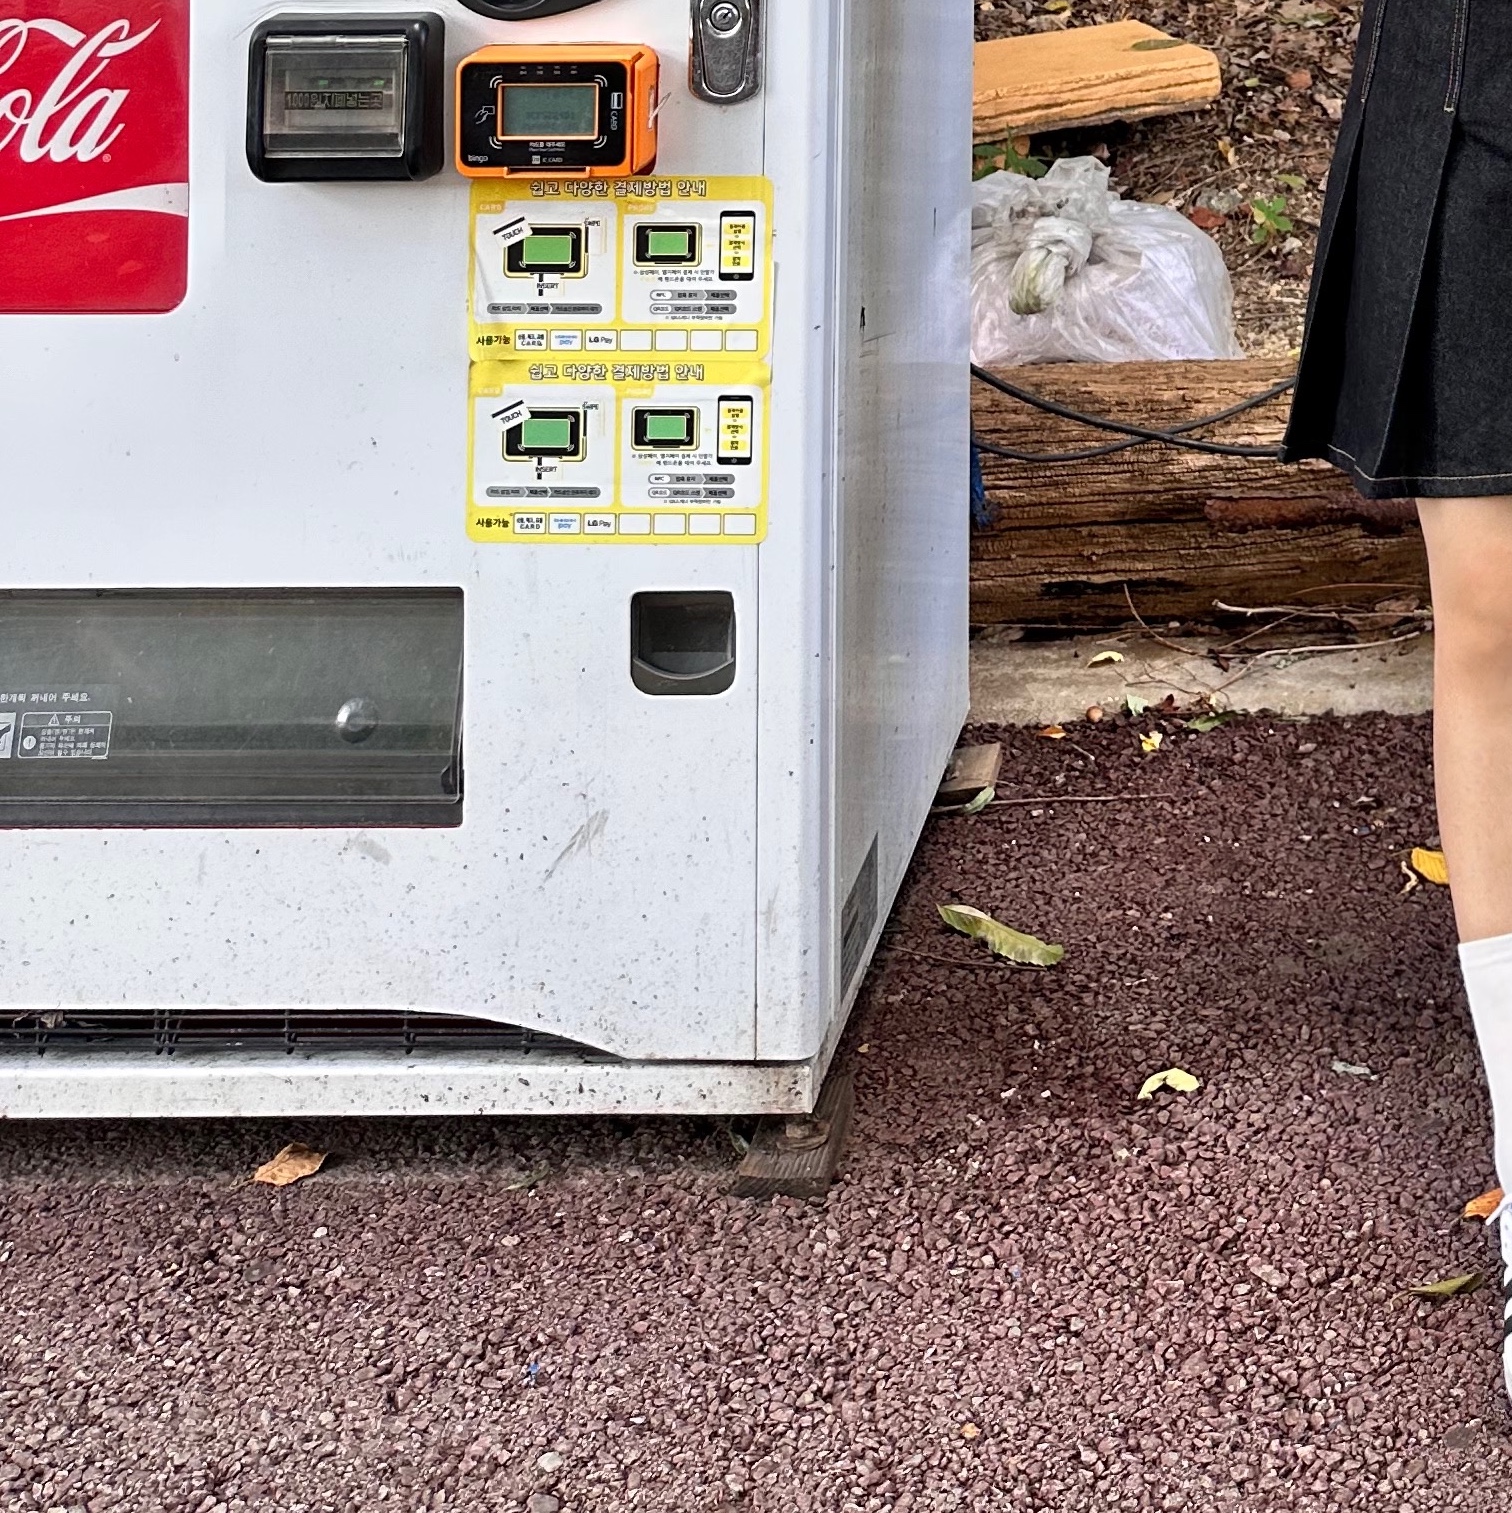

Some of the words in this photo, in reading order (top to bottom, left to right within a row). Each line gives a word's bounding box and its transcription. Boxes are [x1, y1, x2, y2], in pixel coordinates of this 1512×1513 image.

[564, 180, 608, 197] 다양한
[614, 179, 672, 197] 결제방법
[677, 180, 706, 197] 안내
[563, 364, 608, 380] 다양한
[612, 364, 670, 380] 결제방법
[675, 364, 704, 380] 안내
